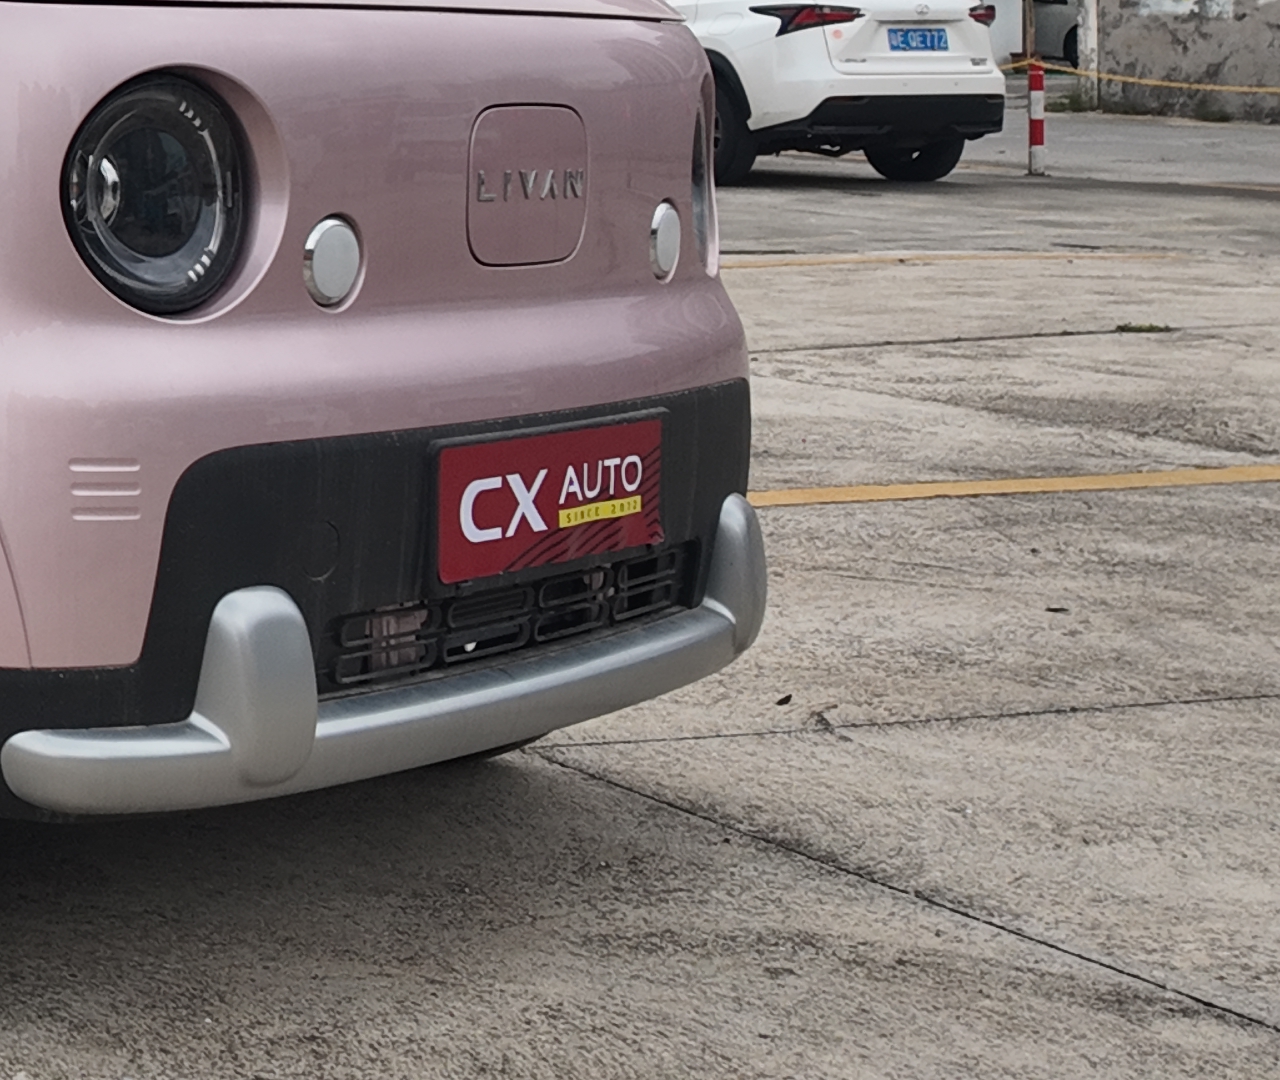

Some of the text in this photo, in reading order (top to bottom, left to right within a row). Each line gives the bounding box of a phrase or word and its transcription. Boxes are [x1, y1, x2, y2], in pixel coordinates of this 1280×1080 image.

[476, 167, 585, 203] LIVAN
[558, 454, 643, 505] AUTO
[459, 468, 549, 544] CX
[566, 499, 638, 524] SINCE 2012
